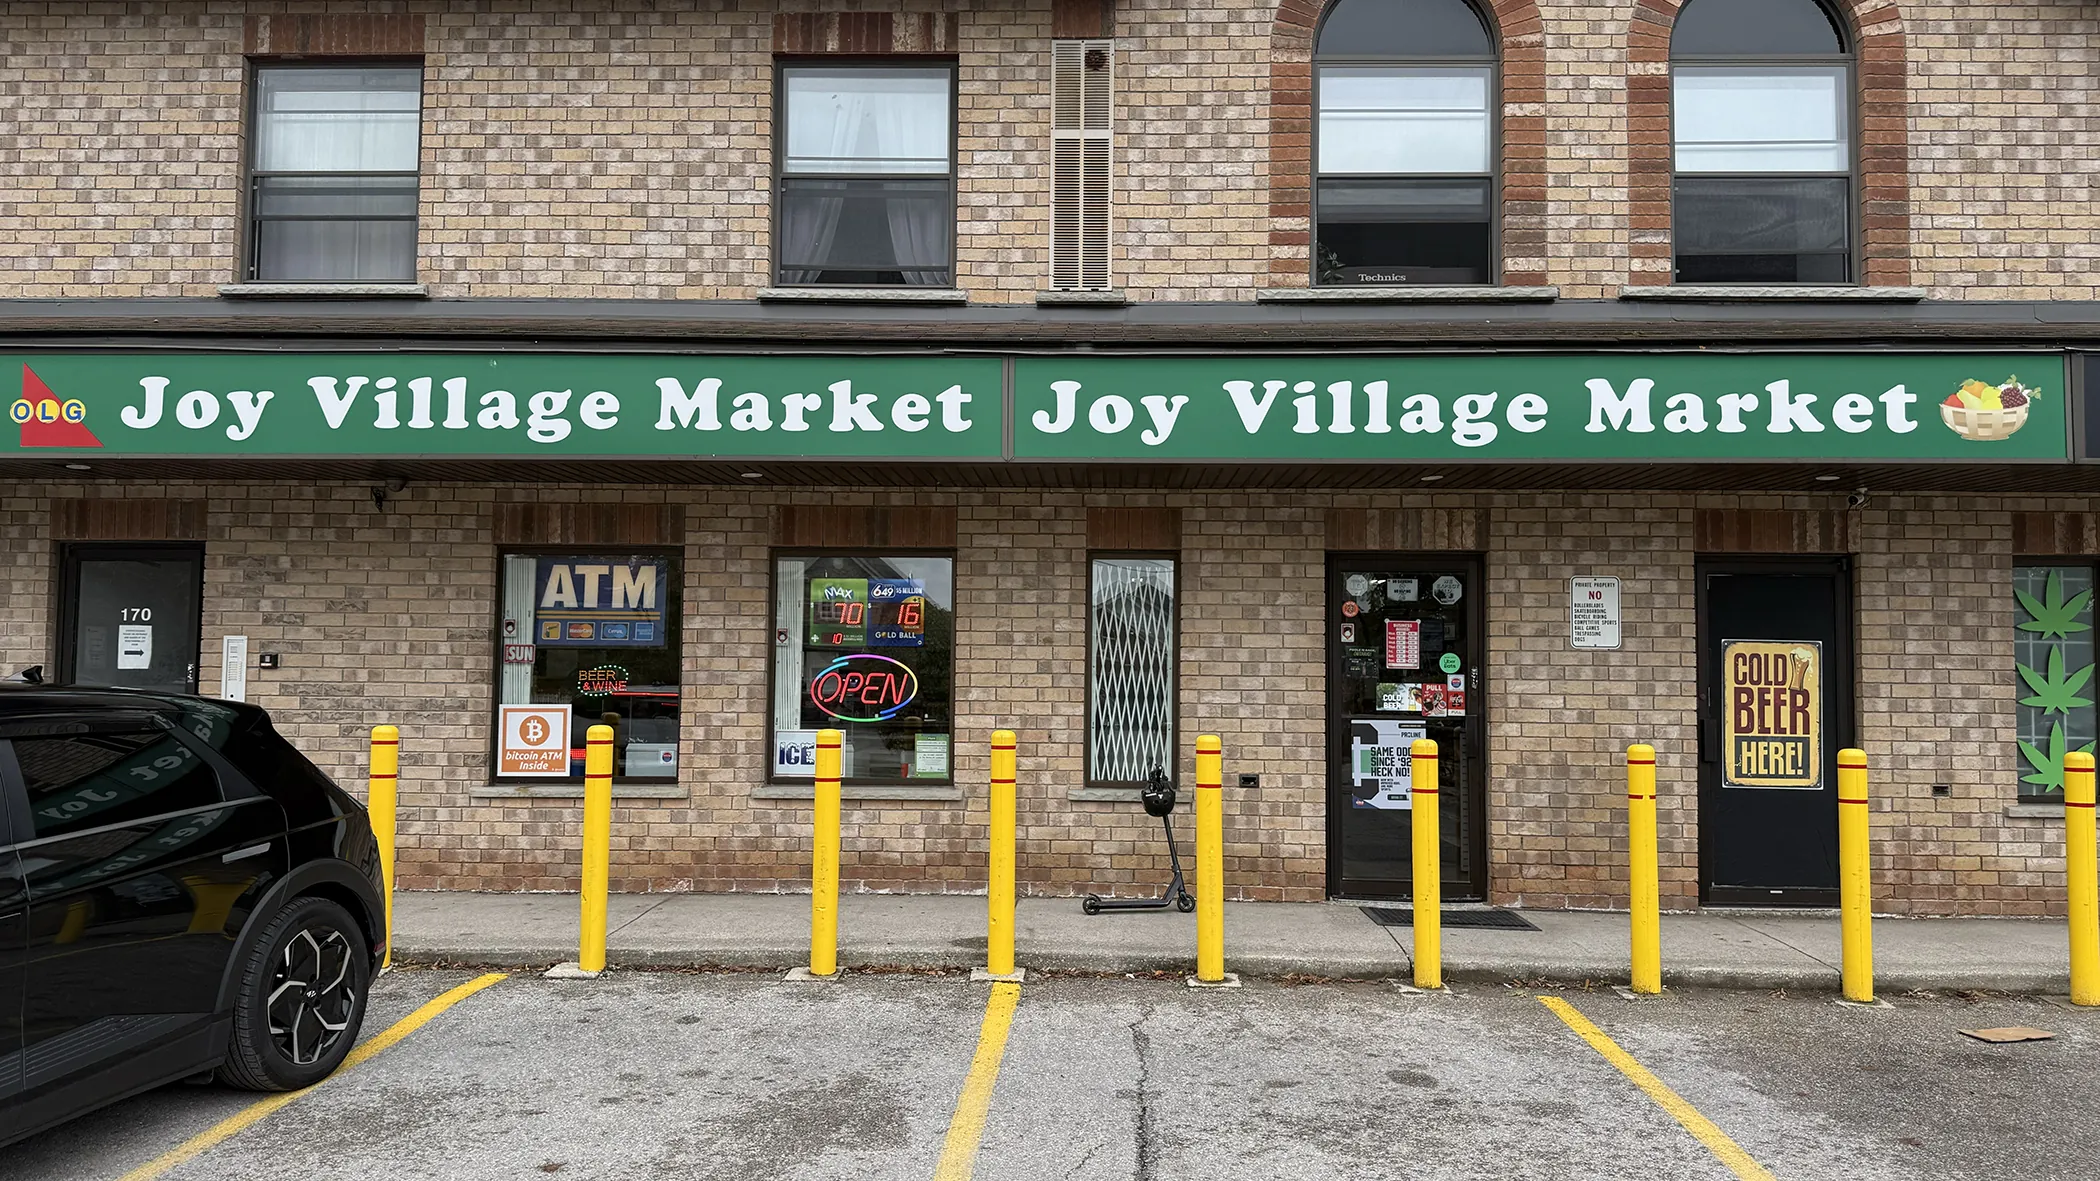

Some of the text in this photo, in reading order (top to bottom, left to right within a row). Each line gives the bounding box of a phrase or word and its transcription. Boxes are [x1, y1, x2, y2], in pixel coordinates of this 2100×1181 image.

[1358, 273, 1406, 281] Technics
[14, 402, 82, 420] OLG
[121, 377, 972, 442] Joy Village Market
[1033, 379, 1917, 446] Joy Village Market
[540, 564, 656, 609] ATM
[824, 586, 853, 600] MAX
[1588, 591, 1602, 600] NO
[121, 608, 152, 621] 170
[835, 602, 864, 625] 70
[897, 603, 920, 625] 16
[832, 633, 843, 645] 10
[899, 631, 917, 639] BALL
[508, 646, 534, 661] SUN
[579, 670, 616, 681] BEER
[1734, 653, 1787, 687] COLD
[583, 681, 628, 692] & WINE
[817, 672, 908, 704] OPEN
[1383, 694, 1402, 702] COLD
[1734, 686, 1811, 735] BEER
[505, 751, 538, 760] bitcoin
[540, 751, 563, 760] ATM
[778, 741, 815, 765] ICE
[1370, 747, 1394, 757] SAME
[1741, 741, 1803, 776] HERE!
[519, 761, 549, 770] Inside
[1370, 757, 1395, 767] SINCE
[1370, 767, 1410, 777] HECK NO!
